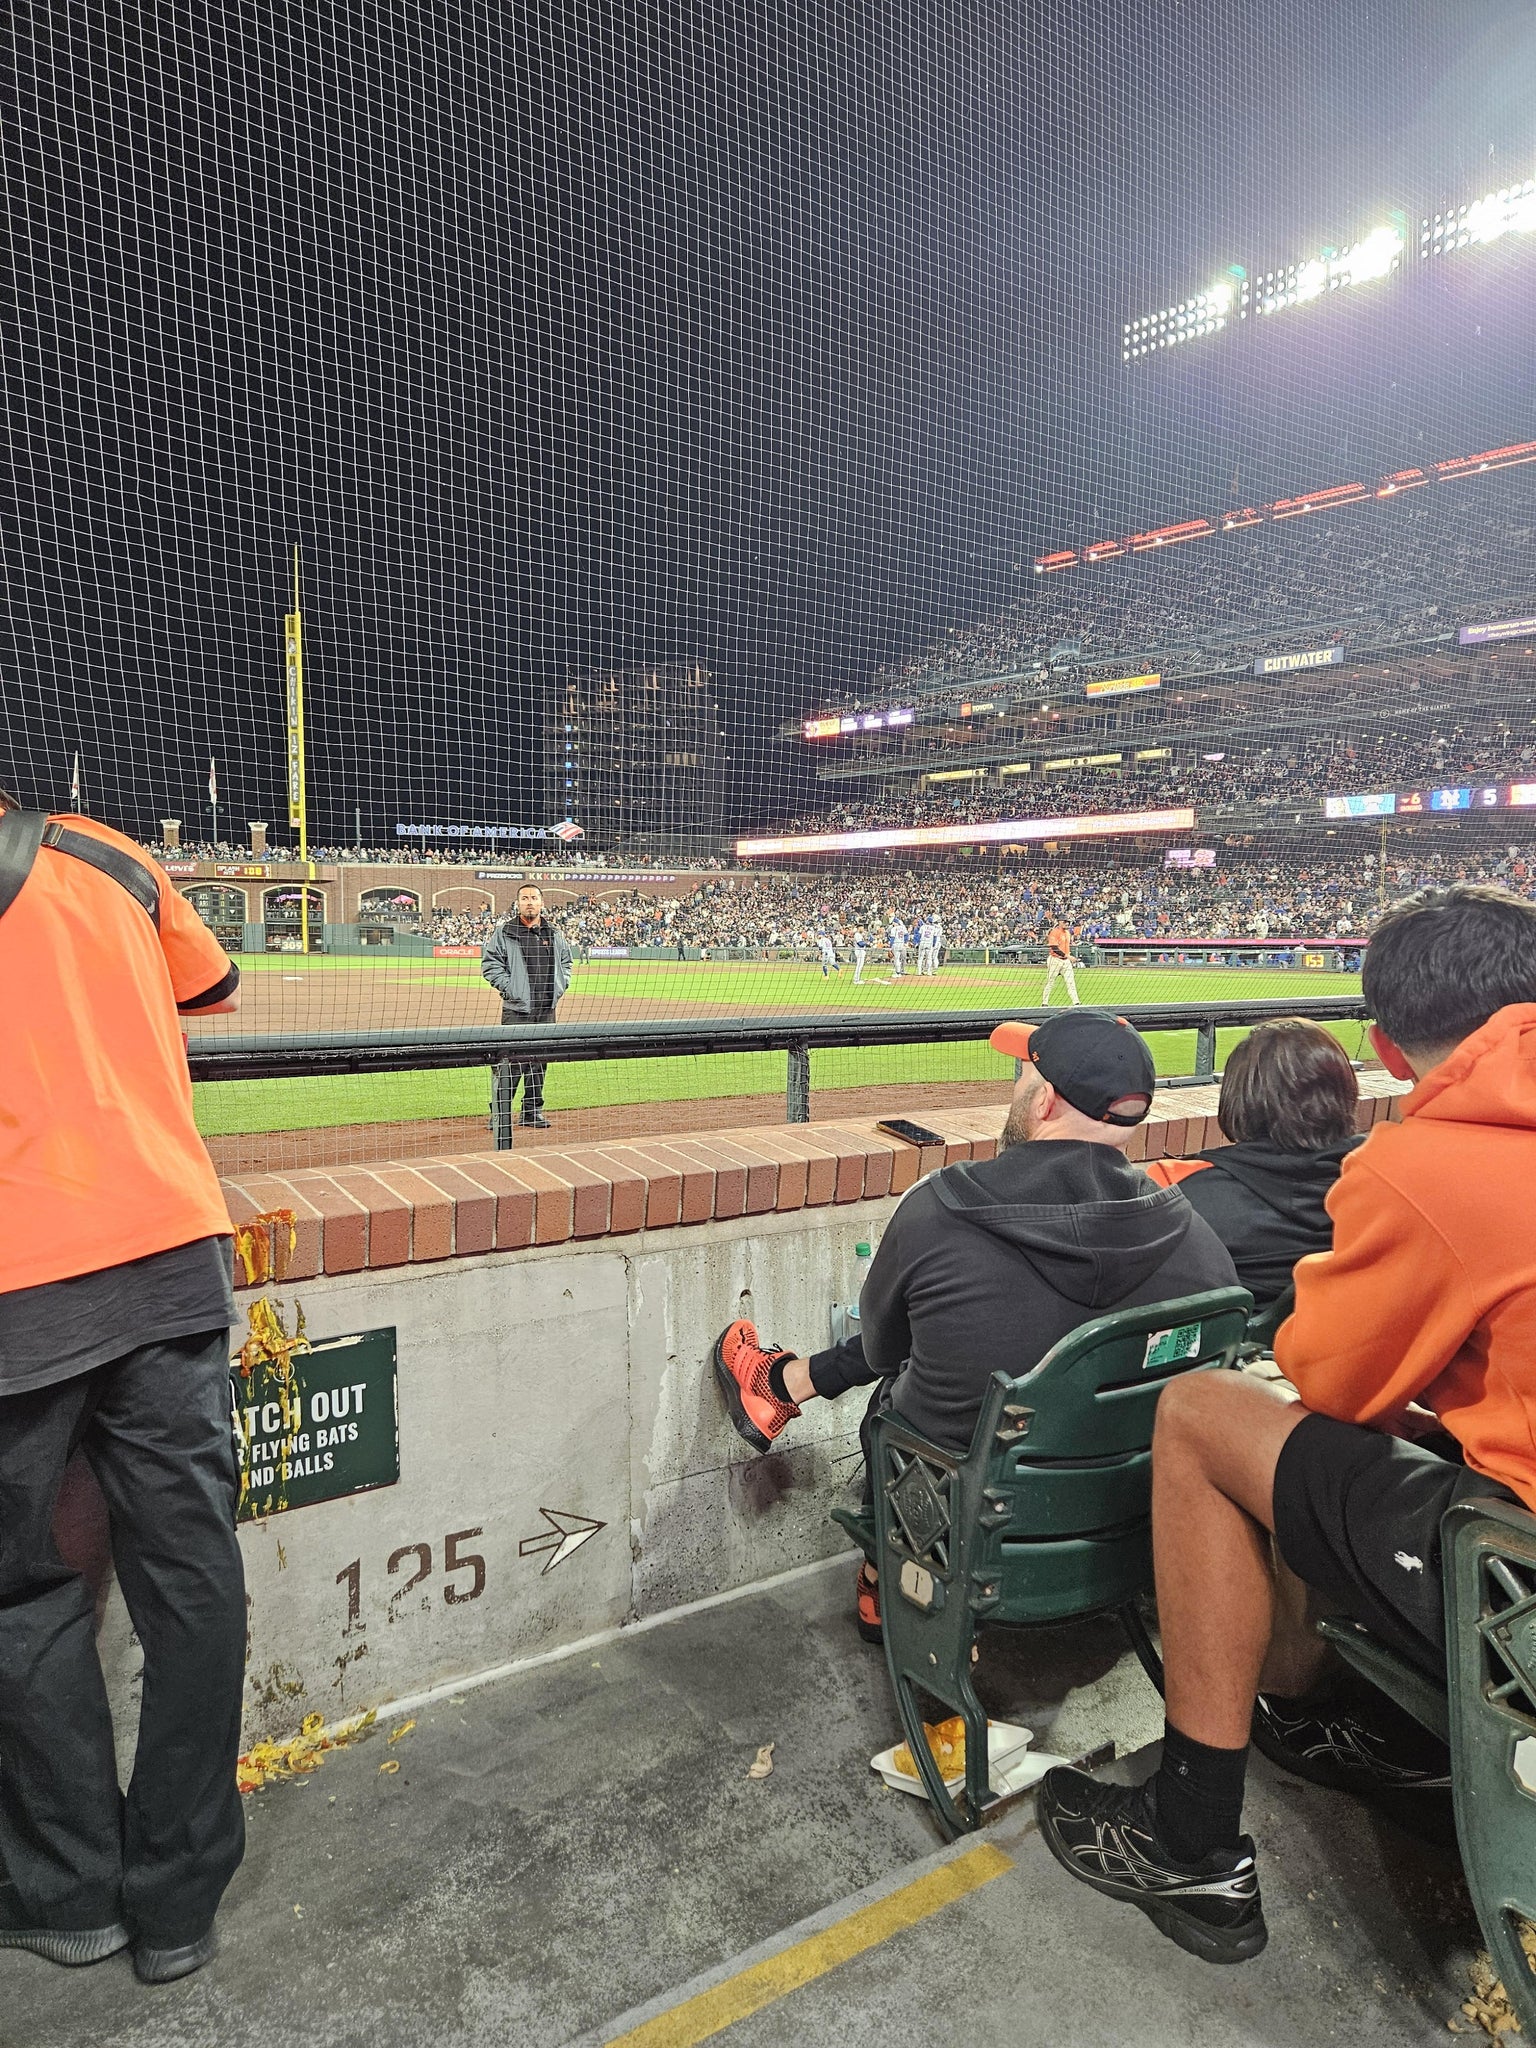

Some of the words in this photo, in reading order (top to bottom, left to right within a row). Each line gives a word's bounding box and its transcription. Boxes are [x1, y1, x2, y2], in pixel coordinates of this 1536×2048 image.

[1264, 649, 1332, 672] CUTWATER
[1483, 788, 1497, 805] 5
[396, 824, 442, 836] BANK
[448, 825, 467, 836] OF
[473, 825, 547, 839] AMERICA
[231, 1397, 302, 1441] ATCH
[311, 1383, 367, 1422] OUT
[252, 1433, 310, 1464] FLYING
[316, 1422, 359, 1449] BATS
[282, 1452, 335, 1481] BALLS
[336, 1527, 486, 1638] 125
